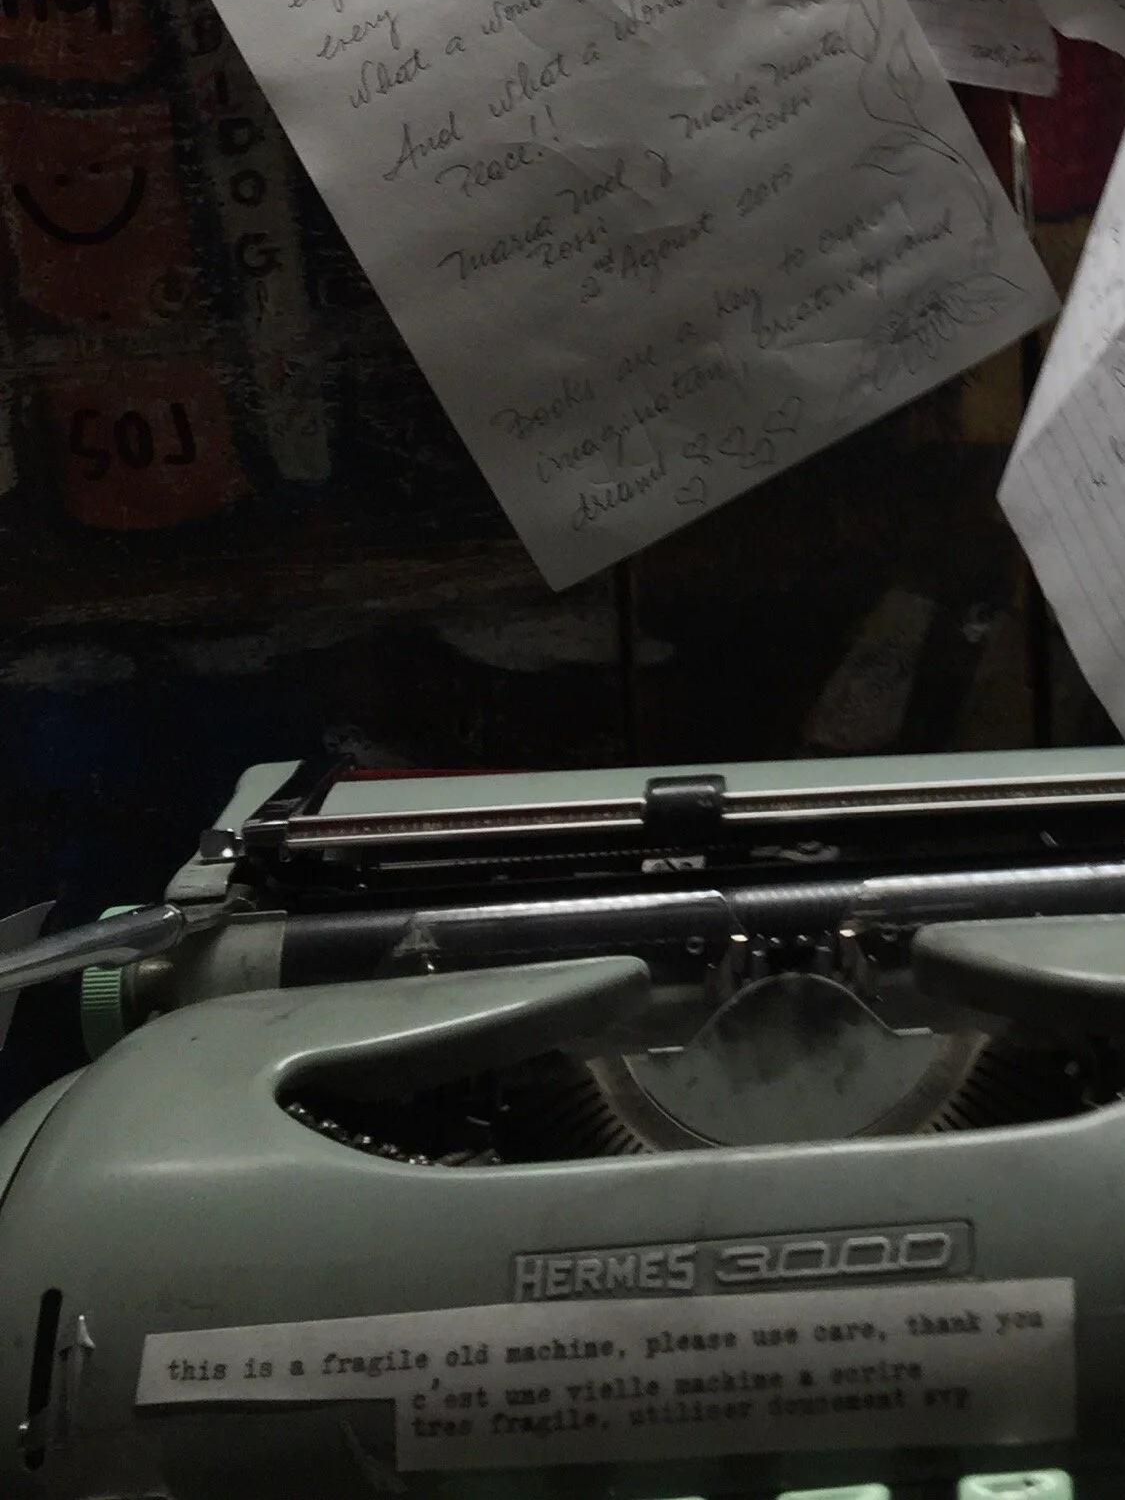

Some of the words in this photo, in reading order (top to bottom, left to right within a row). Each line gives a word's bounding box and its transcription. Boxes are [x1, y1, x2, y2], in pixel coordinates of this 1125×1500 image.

[318, 7, 401, 61] every
[444, 34, 467, 56] a
[382, 109, 464, 182] And
[581, 41, 602, 67] a
[513, 1246, 696, 1302] HERMES
[714, 1230, 956, 1282] 3000
[166, 1357, 228, 1382] this
[243, 1358, 274, 1380] is
[289, 1358, 305, 1376] a
[321, 1349, 430, 1378] fragile
[444, 1342, 489, 1367] old
[504, 1337, 628, 1365] machine,
[645, 1329, 738, 1360] please
[752, 1327, 798, 1347] use
[813, 1320, 888, 1344] care,
[904, 1307, 982, 1337] thank
[994, 1309, 1045, 1337] you
[411, 1376, 490, 1411] c'est
[504, 1386, 552, 1406] une
[674, 1368, 785, 1397] machine
[411, 1416, 474, 1439] tres
[490, 1406, 611, 1439] fragile,
